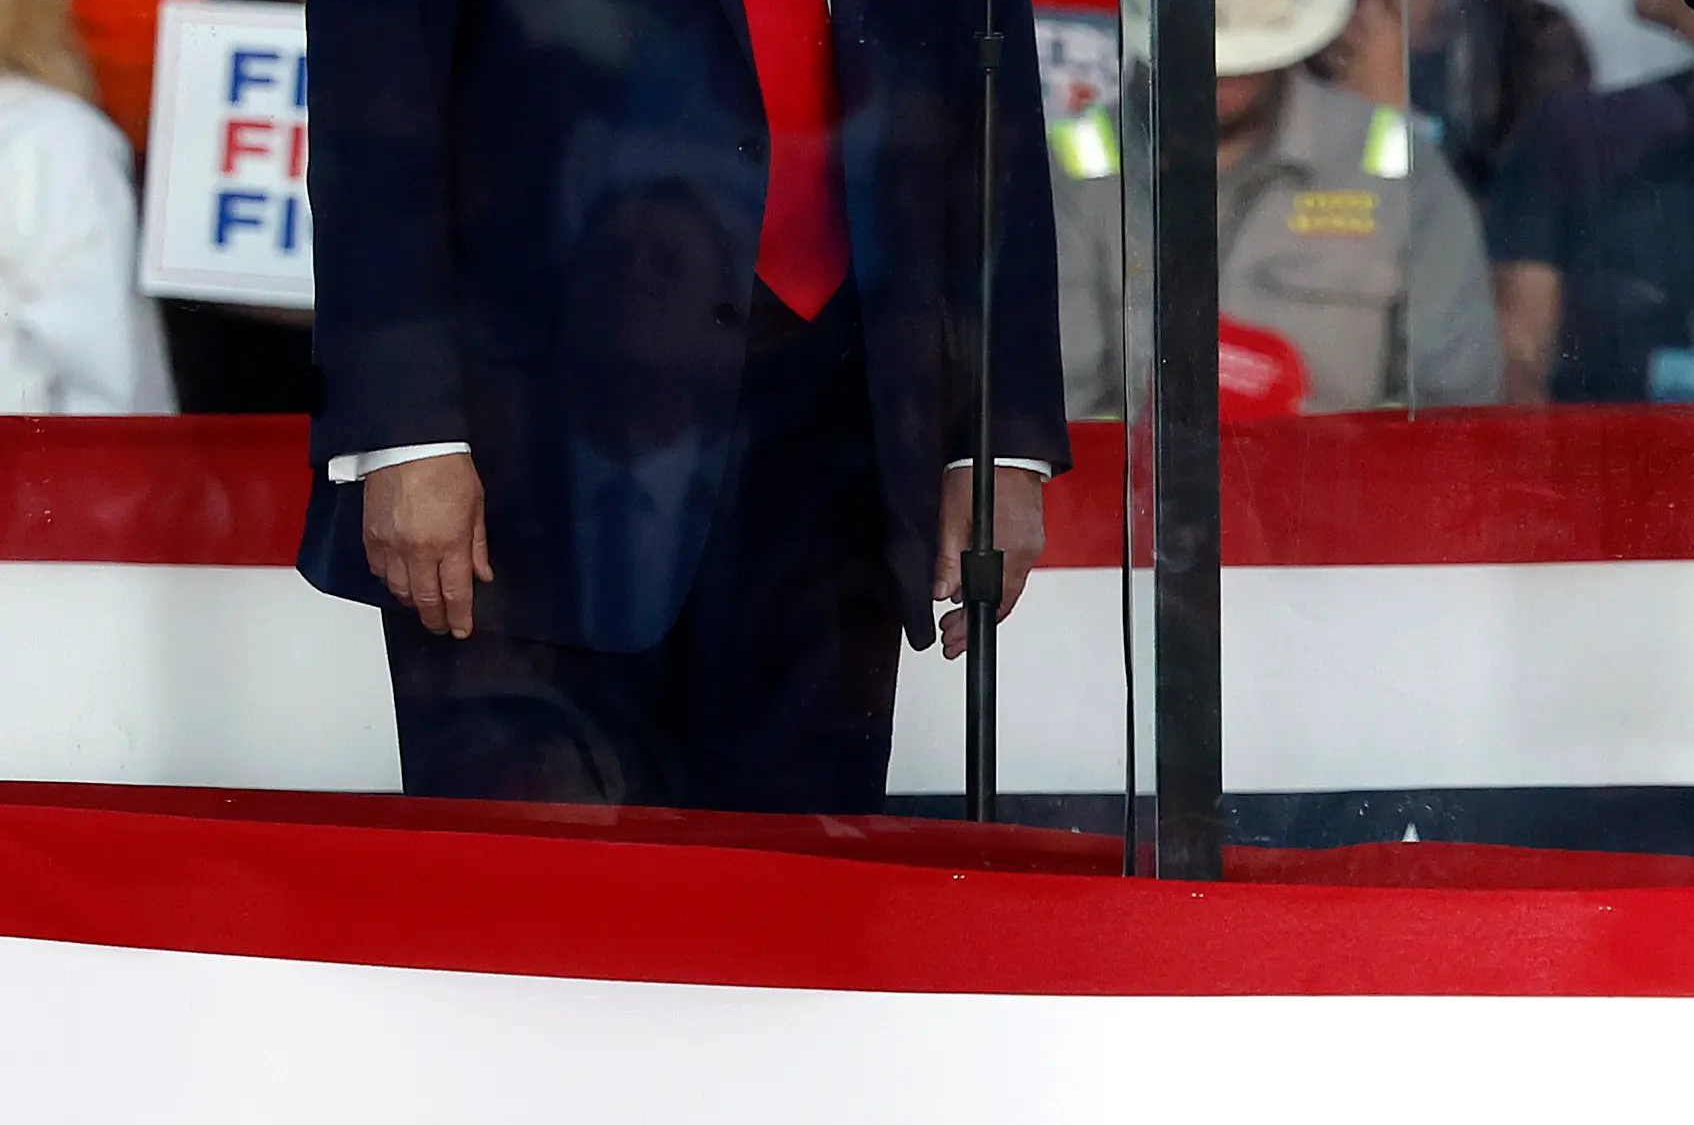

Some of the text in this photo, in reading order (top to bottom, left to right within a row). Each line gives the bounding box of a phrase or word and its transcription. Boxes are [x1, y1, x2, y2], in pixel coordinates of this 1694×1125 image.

[228, 50, 307, 106] FI
[220, 119, 304, 180] FI
[213, 190, 297, 252] FI
